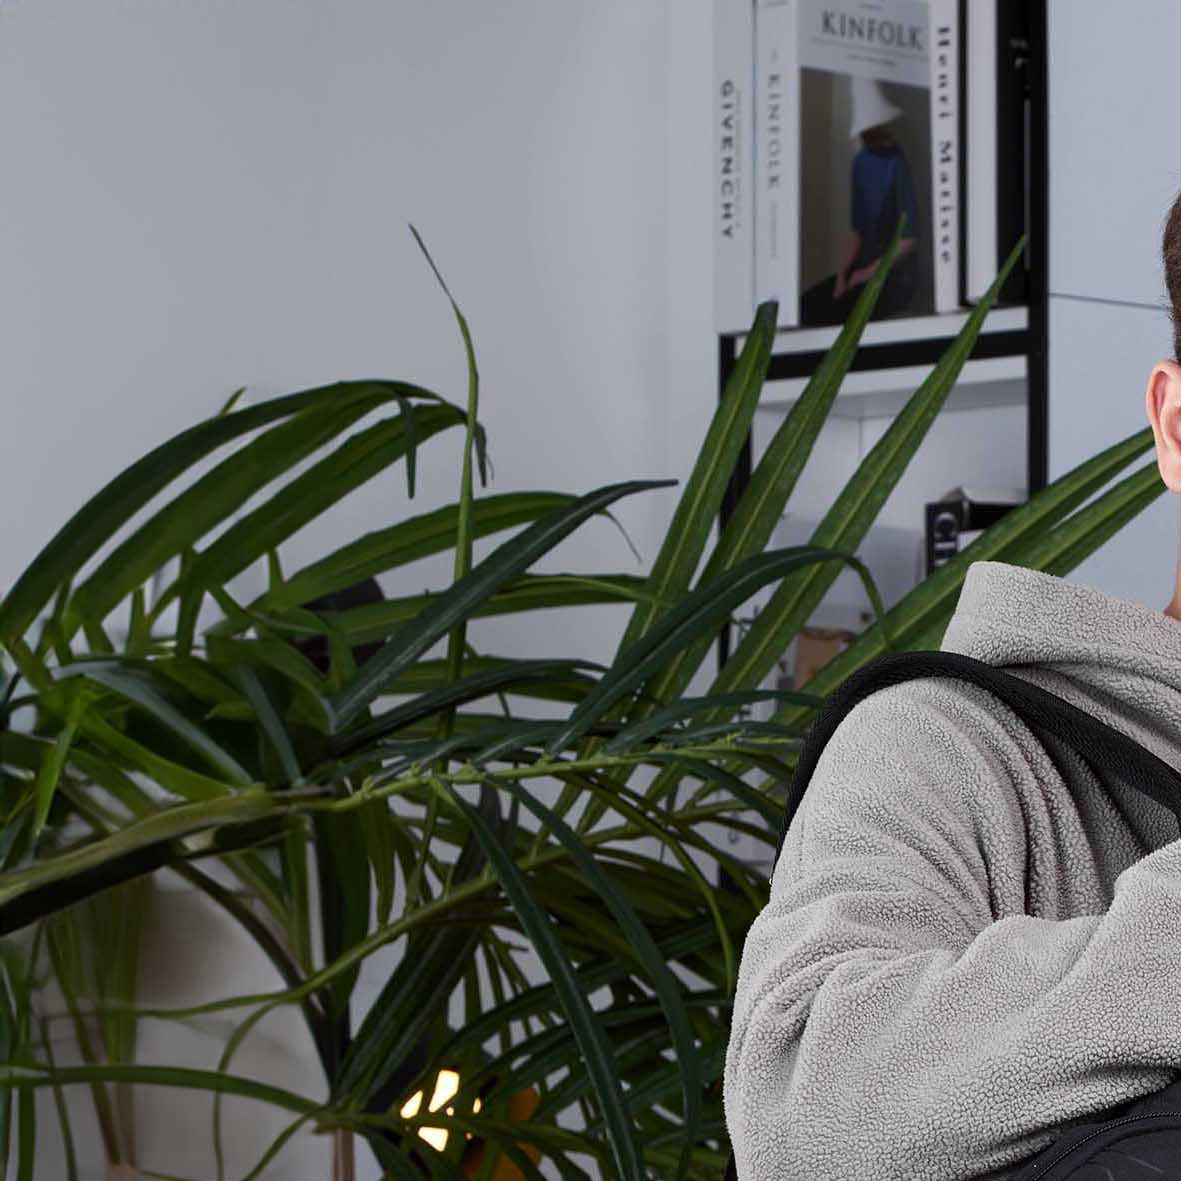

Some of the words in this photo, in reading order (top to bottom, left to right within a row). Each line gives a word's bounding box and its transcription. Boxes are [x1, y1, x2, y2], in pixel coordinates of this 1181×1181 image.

[820, 9, 924, 51] KINFOLK
[938, 26, 951, 120] Henri
[721, 80, 734, 239] GIVENCHY
[767, 74, 781, 190] KINFOLK
[939, 140, 952, 264] Matisse
